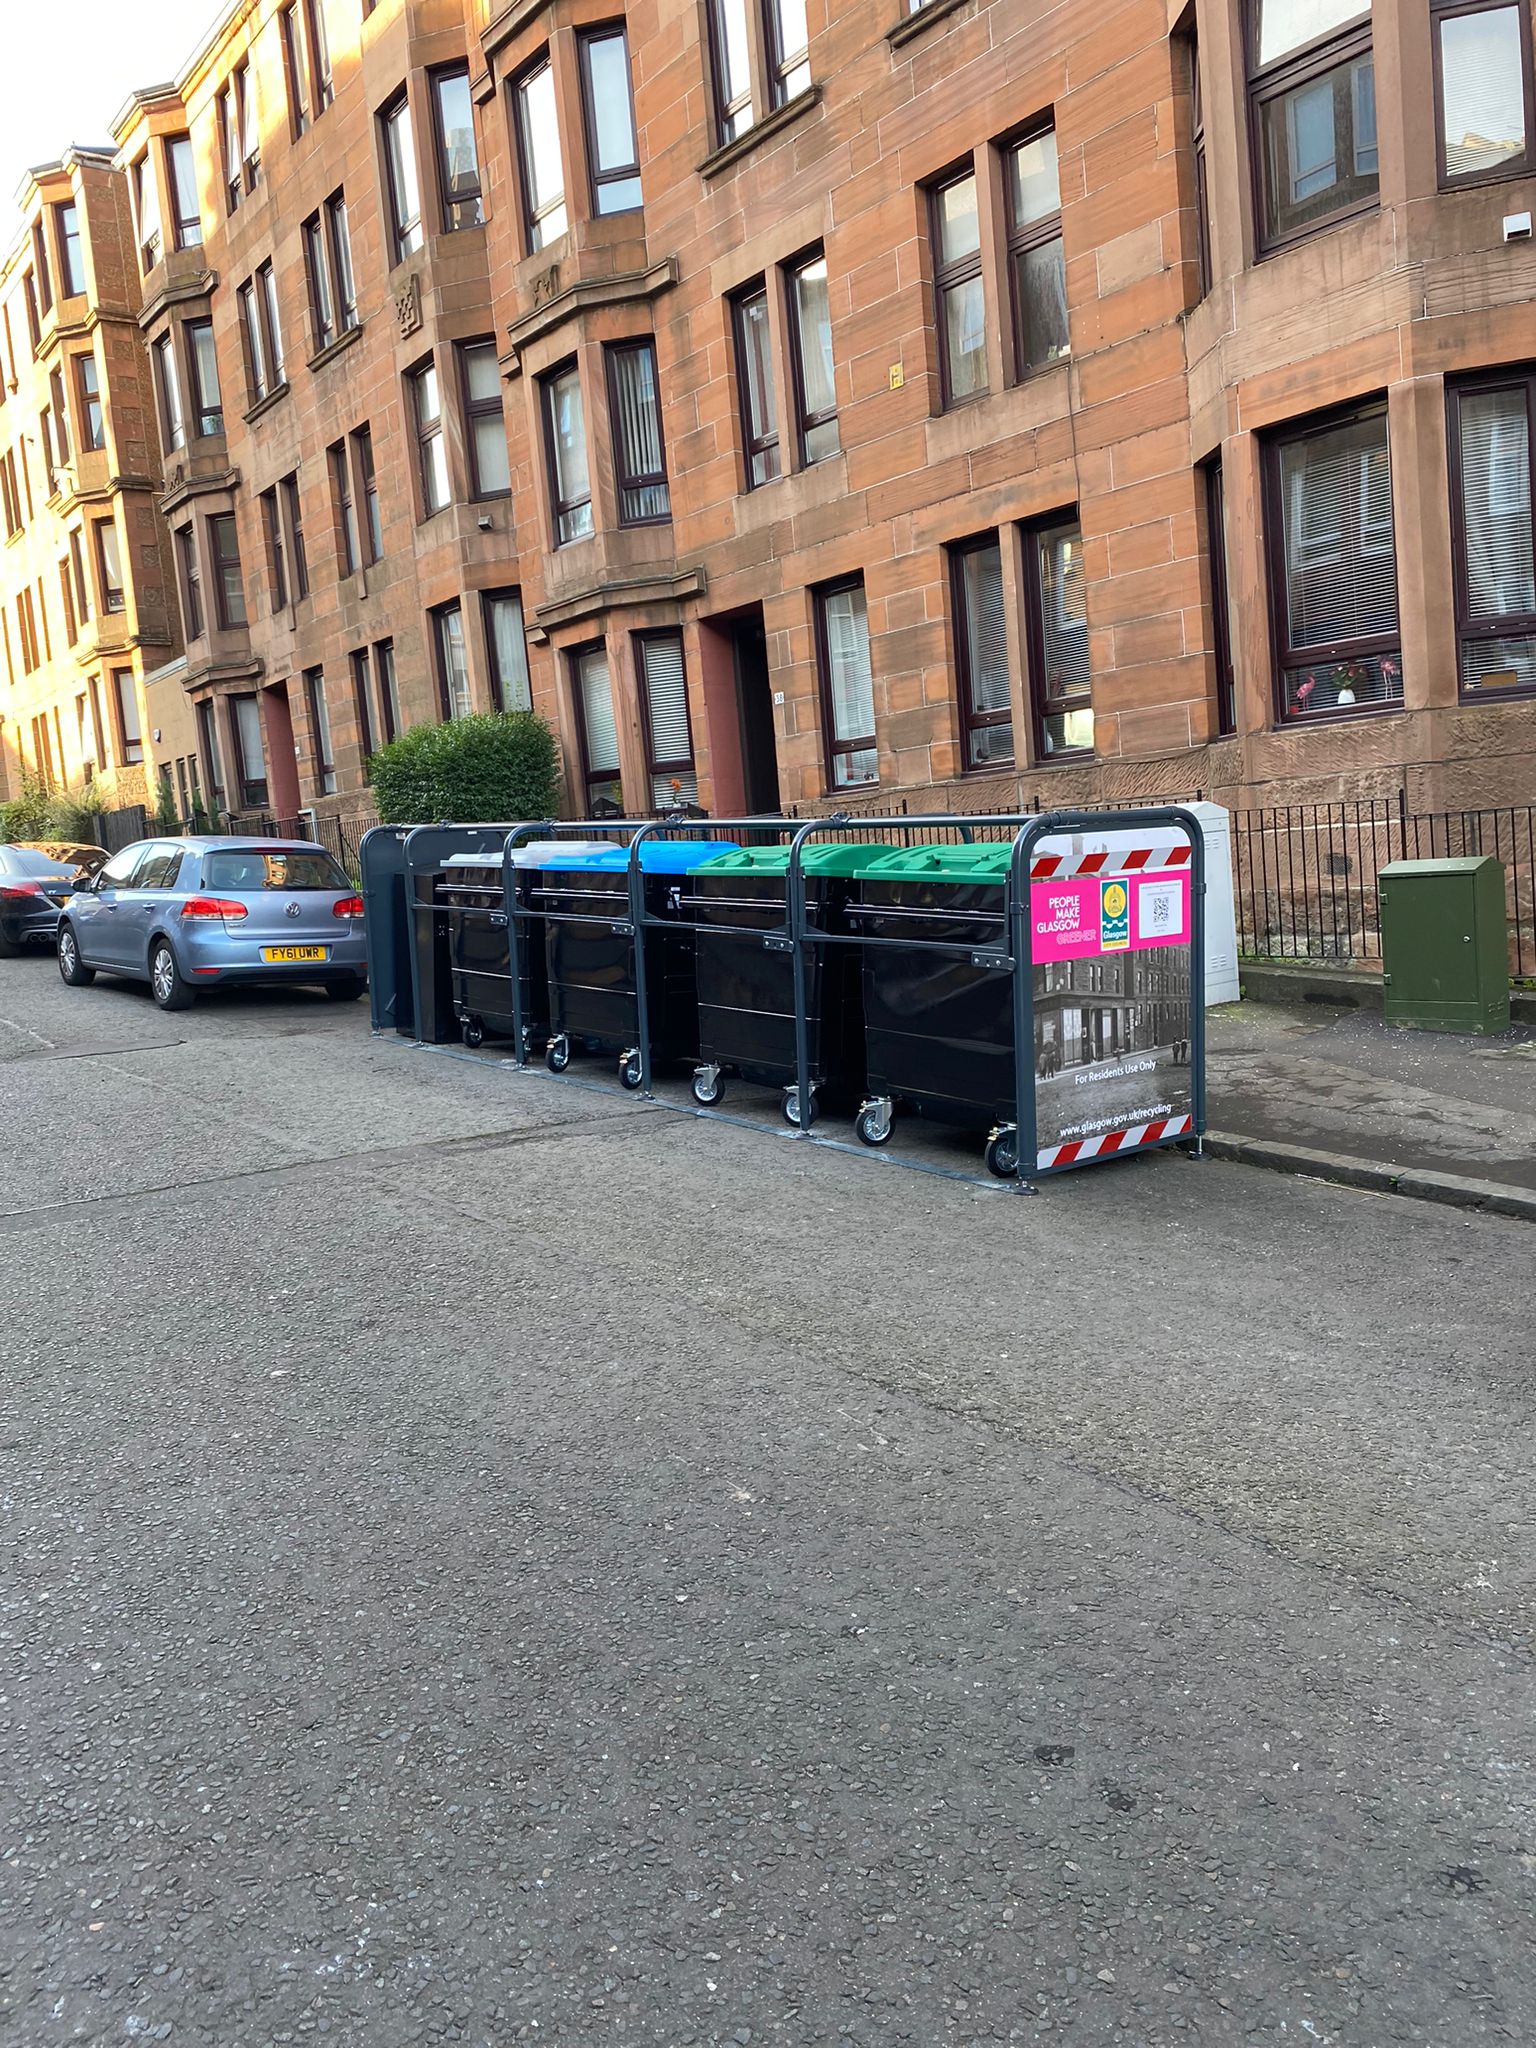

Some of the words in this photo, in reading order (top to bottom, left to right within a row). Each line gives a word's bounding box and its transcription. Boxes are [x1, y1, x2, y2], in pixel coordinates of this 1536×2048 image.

[1049, 895, 1080, 909] PEOPLE
[1056, 907, 1080, 920] MAKE
[1037, 918, 1080, 933] GLASGOW
[1103, 931, 1127, 940] Glasgow
[272, 948, 297, 959] FY61
[299, 947, 320, 958] UWR
[1075, 1074, 1088, 1085] For
[1088, 1068, 1124, 1082] Residents
[1125, 1064, 1138, 1074] Use
[1139, 1059, 1156, 1071] Only
[1060, 1104, 1172, 1137] www.glasgow.gov.uk/recycling
